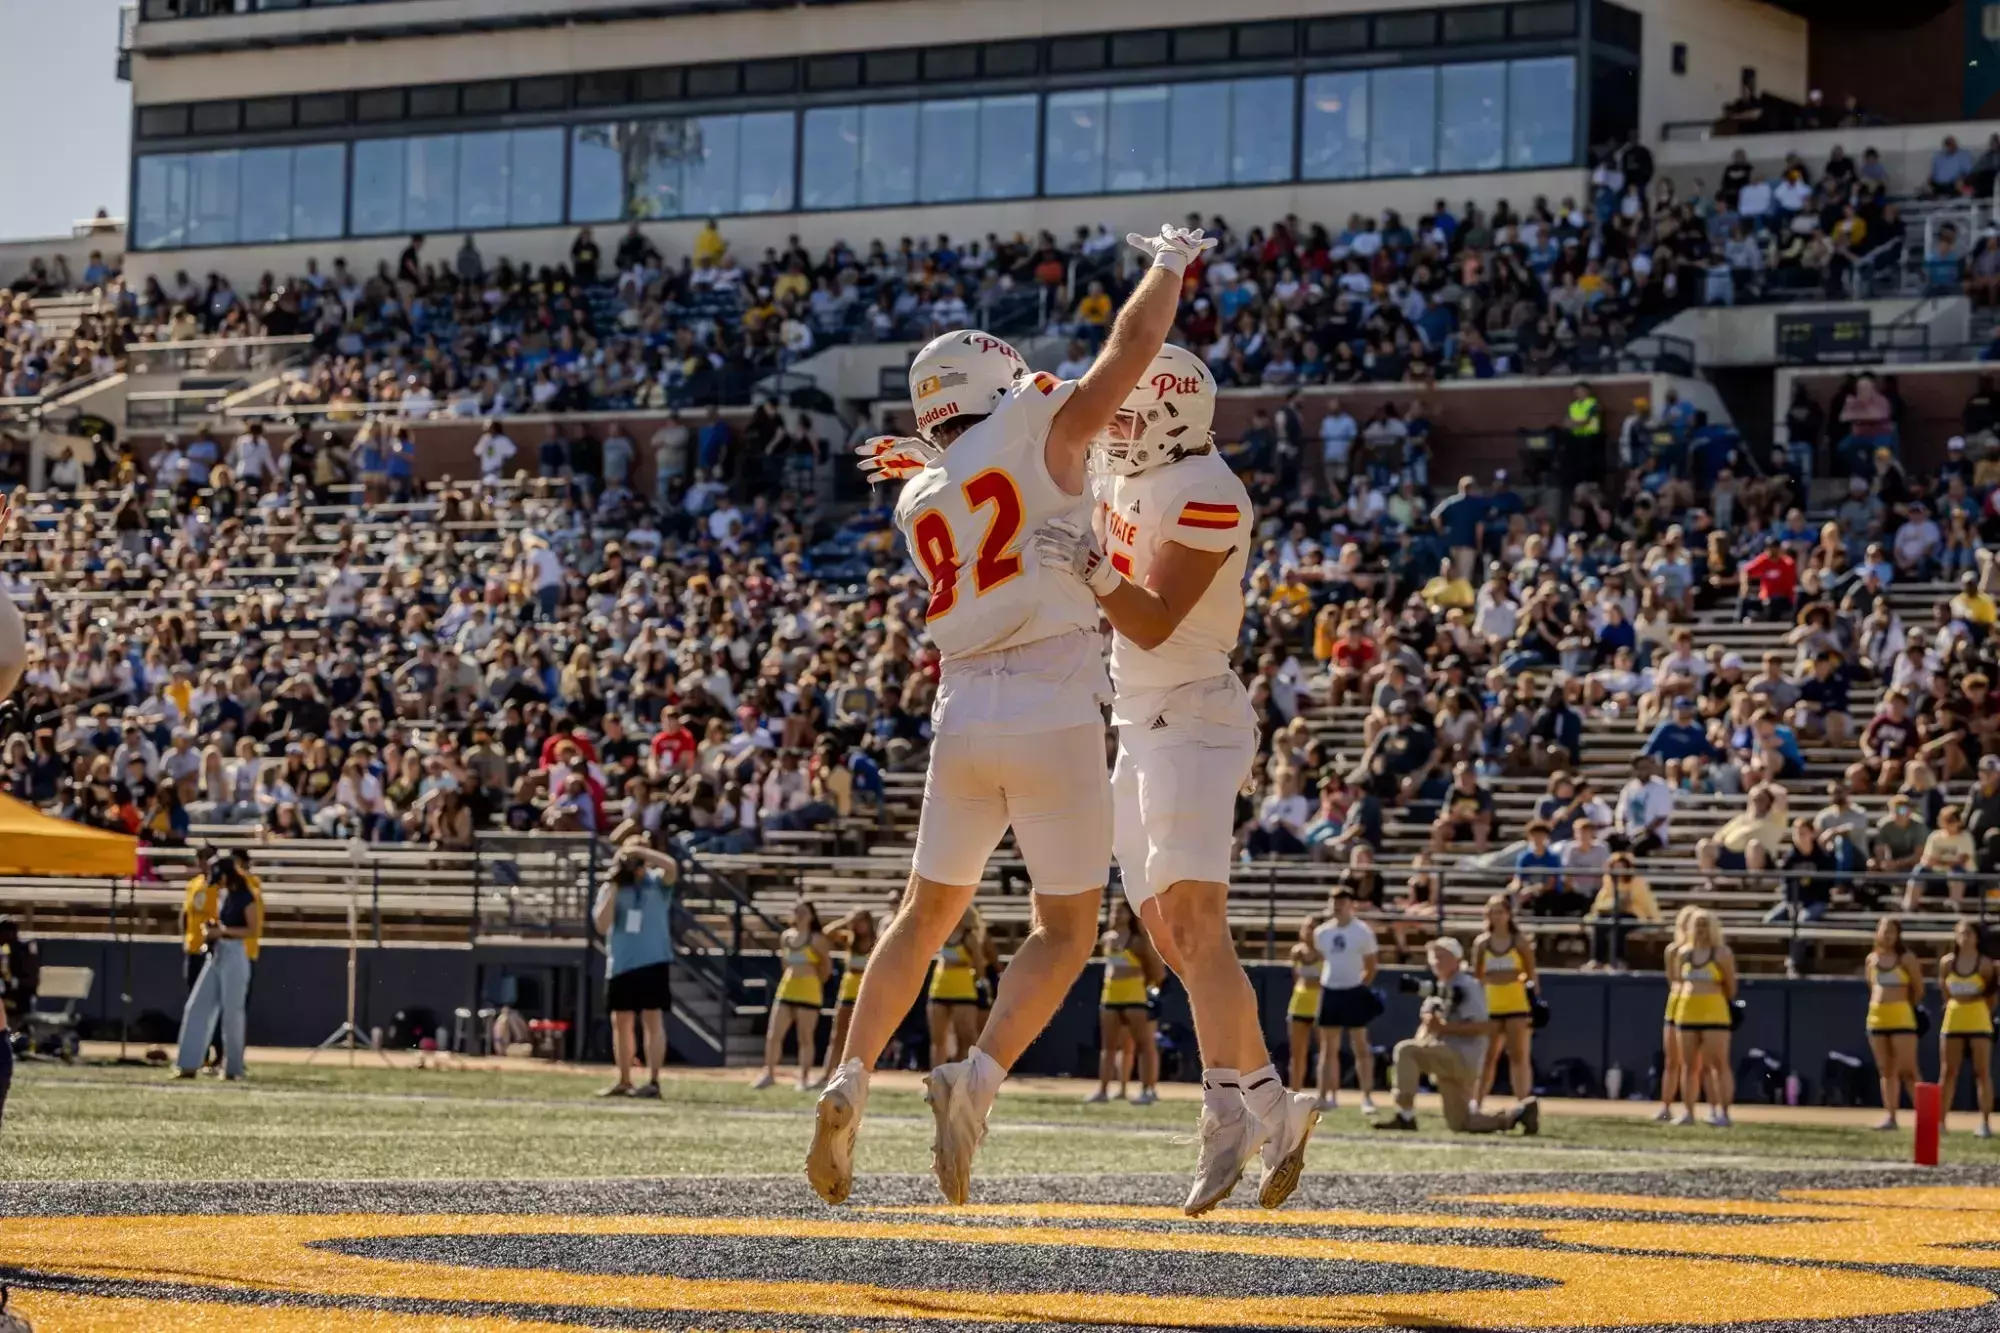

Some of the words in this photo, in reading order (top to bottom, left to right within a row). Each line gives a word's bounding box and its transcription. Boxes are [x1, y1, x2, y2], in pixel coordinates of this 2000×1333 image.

[1151, 374, 1200, 400] Pitt
[918, 402, 959, 429] Riddell
[912, 467, 1026, 623] 82
